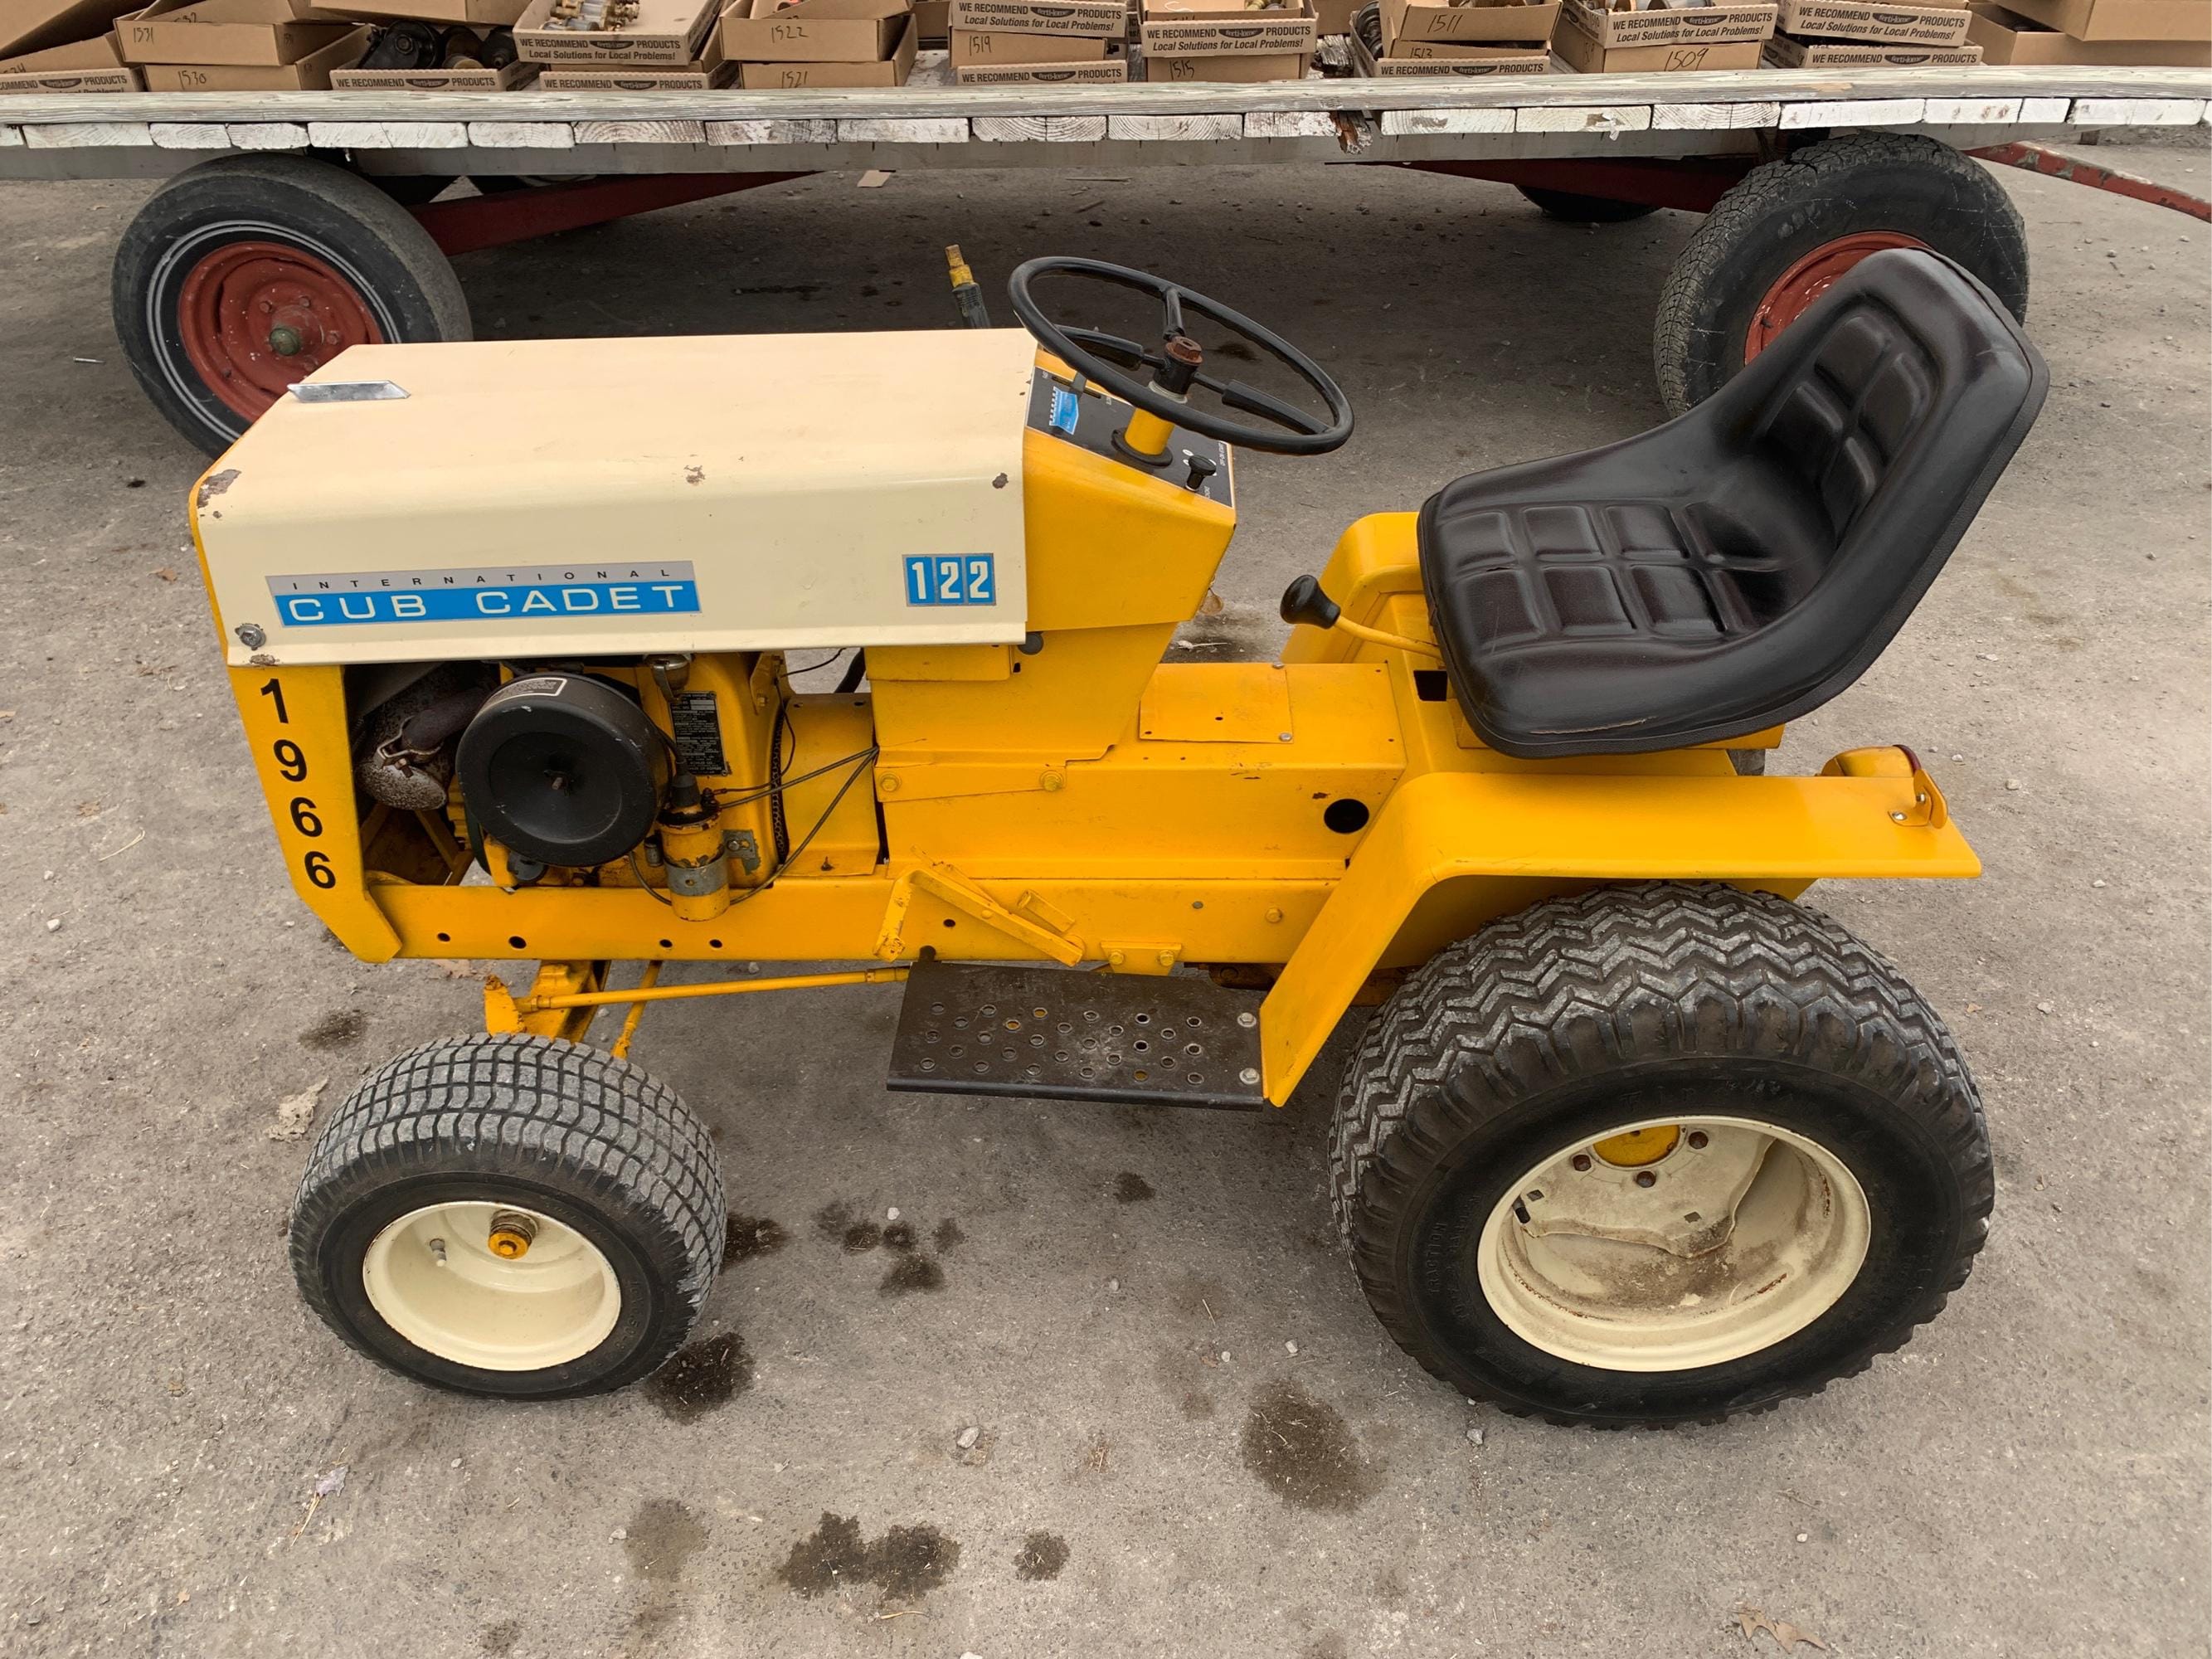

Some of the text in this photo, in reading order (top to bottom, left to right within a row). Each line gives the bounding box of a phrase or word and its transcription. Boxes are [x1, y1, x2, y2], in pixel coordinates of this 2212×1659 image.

[959, 2, 972, 12] WE
[975, 3, 1028, 14] RECOMMEND
[1077, 8, 1121, 19] PRODUCTS
[1799, 7, 1813, 17] WE
[1815, 8, 1870, 21] RECOMMEND
[1919, 16, 1965, 27] PRODUCTS
[965, 15, 1114, 31] Local Solutions for Local Problems!
[1427, 14, 1462, 33] 1511
[1613, 21, 1626, 30] WE
[1628, 17, 1680, 29] RECOMMEND
[1728, 13, 1772, 23] PRODUCTS
[771, 26, 809, 43] 1522
[1147, 30, 1160, 38] WE
[1162, 28, 1217, 38] RECOMMEND
[1266, 26, 1310, 36] PRODUCTS
[1616, 26, 1763, 42] Local Solutions for Local Problems!
[1801, 20, 1955, 40] Local Solutions for Local Problems!
[519, 38, 534, 47] WE
[536, 39, 588, 48] RECOMMEND
[636, 40, 681, 49] PRODUCTS
[969, 35, 992, 56] 1519
[1153, 38, 1303, 51] Local Solutions for Local Problems!
[529, 50, 551, 58] Local
[553, 51, 592, 59] Solutions
[609, 51, 630, 60] Local
[634, 51, 675, 61] Problems!
[1664, 48, 1709, 72] 1509
[1812, 55, 1826, 63] WE
[1827, 54, 1882, 63] RECOMMEND
[1932, 54, 1977, 63] PRODUCTS
[962, 74, 975, 82] WE
[977, 72, 1029, 82] RECOMMEND
[1078, 69, 1121, 79] PRODUCTS
[1169, 60, 1194, 80] 1515
[1381, 66, 1394, 75] WE
[1396, 66, 1450, 75] RECOMMEND
[1499, 64, 1544, 73] PRODUCTS
[84, 75, 127, 85] PRODUCTS
[336, 79, 350, 87] WE
[351, 78, 405, 87] RECOMMEND
[451, 77, 495, 86] PRODUCTS
[544, 80, 557, 88] WE
[559, 80, 612, 89] RECOMMEND
[659, 80, 702, 89] PRODUCTS
[292, 569, 670, 590] INTERNATIONAL
[912, 561, 989, 599] 122
[288, 585, 683, 622] CUB CADET
